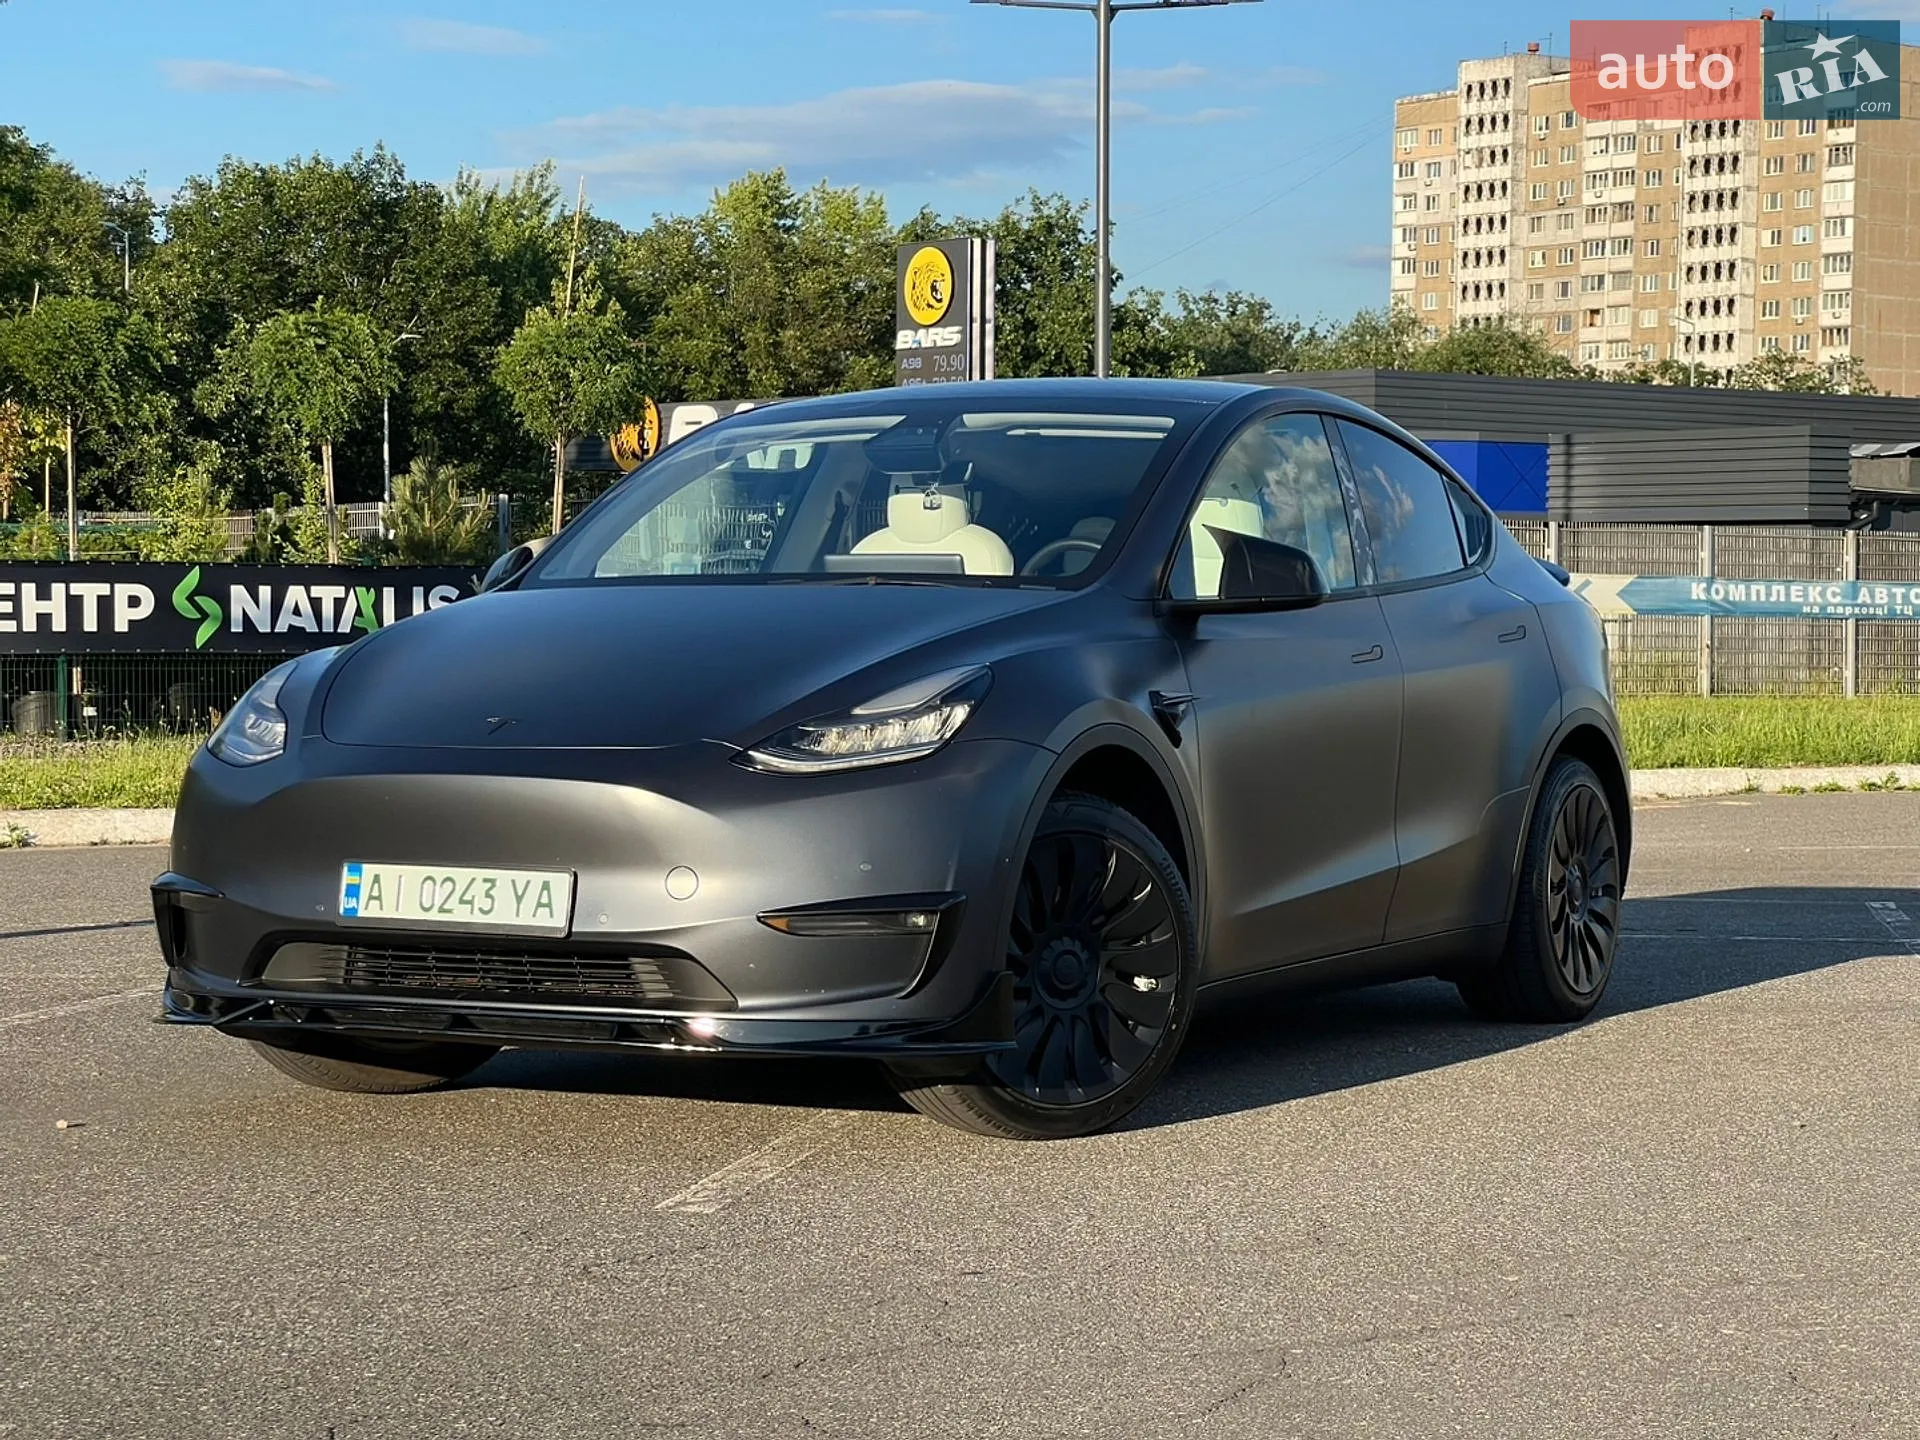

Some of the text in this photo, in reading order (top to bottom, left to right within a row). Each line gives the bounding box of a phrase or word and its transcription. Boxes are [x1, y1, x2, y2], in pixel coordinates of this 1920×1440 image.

[895, 326, 963, 350] BARS
[933, 354, 965, 372] 79.90
[1691, 582, 1842, 603] КОМПЛЕКС
[0, 582, 155, 633] ЕНТР
[1802, 605, 1913, 616] на парковці ТЦ
[343, 895, 358, 909] UA
[364, 873, 555, 919] AI 0243 YA
